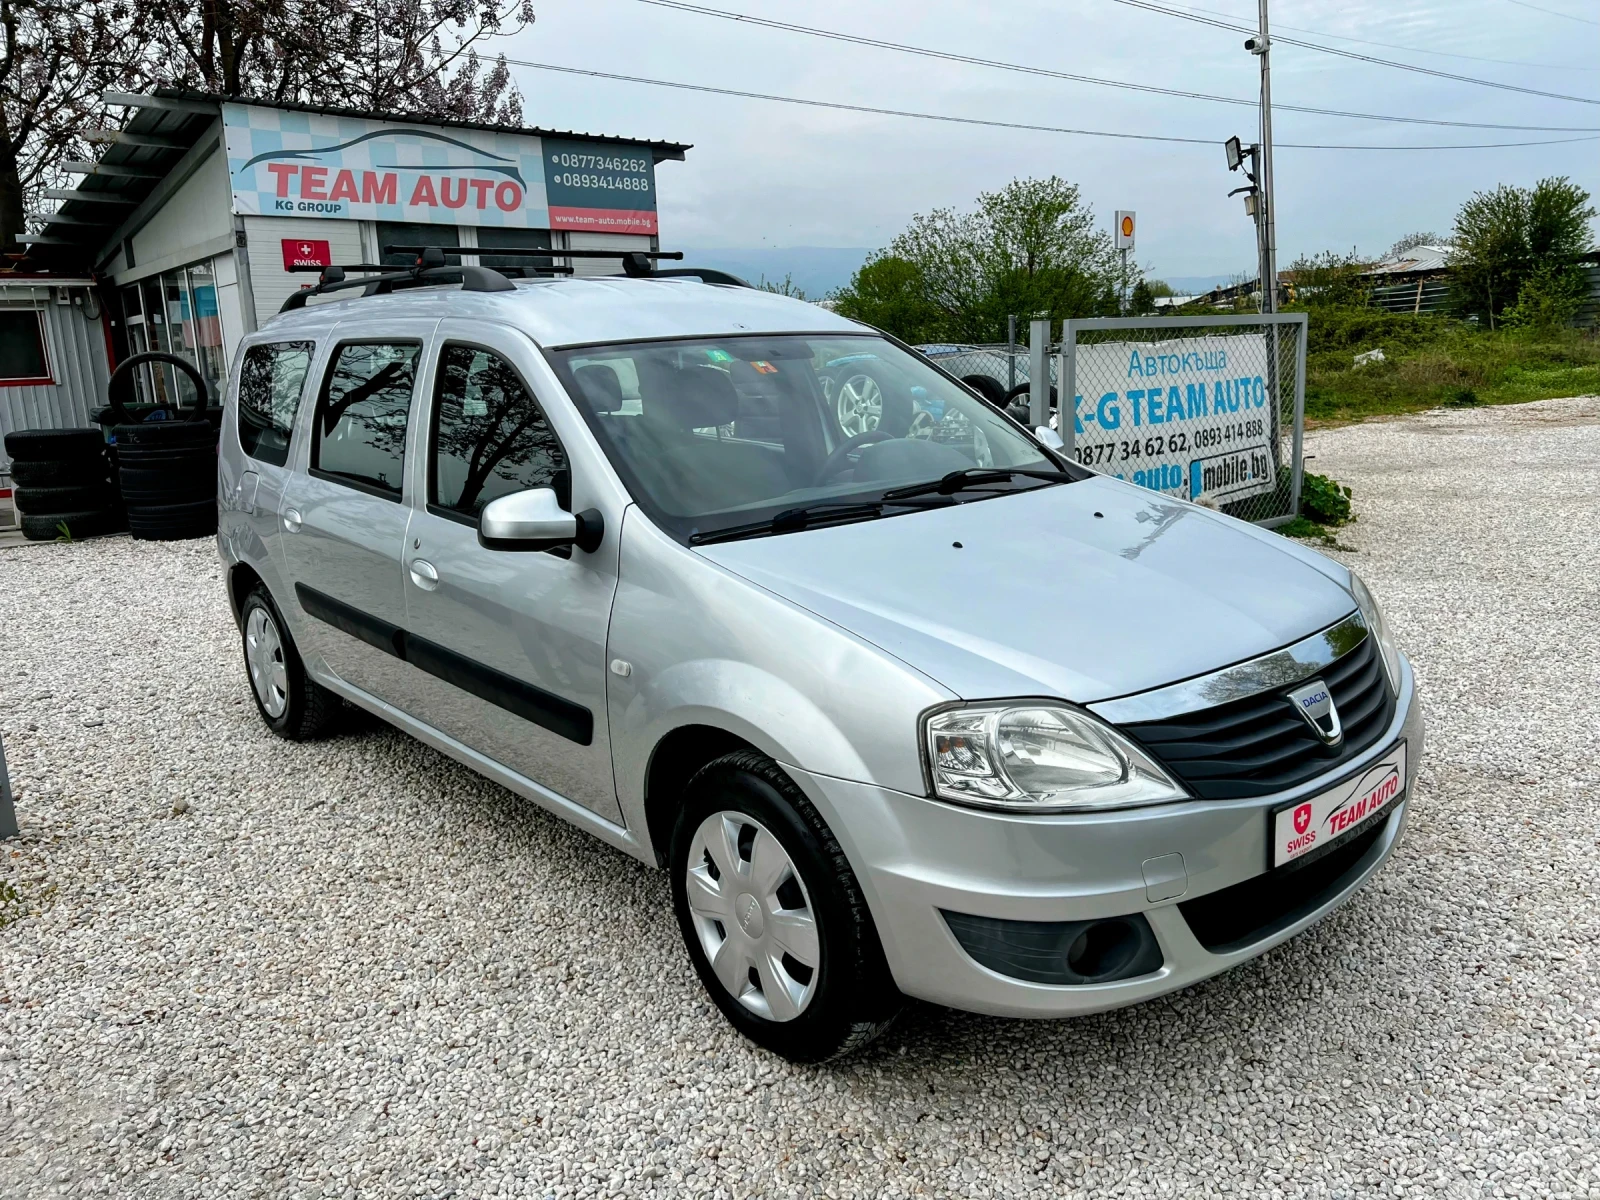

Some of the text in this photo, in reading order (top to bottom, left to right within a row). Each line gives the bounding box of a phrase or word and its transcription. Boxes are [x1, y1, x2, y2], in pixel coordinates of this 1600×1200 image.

[561, 153, 647, 173] 0877346262
[267, 163, 523, 212] TEAM AUTO
[563, 173, 649, 191] 0893414888
[275, 200, 342, 214] KG GROUP
[555, 215, 651, 228] www.team-auto.mobile.bg
[1127, 350, 1227, 378] Автокъща
[1127, 382, 1208, 427] TEAM
[1214, 375, 1265, 415] AUTO
[1121, 439, 1141, 460] 34
[1145, 436, 1165, 456] 62
[1194, 427, 1221, 448] 0893
[1225, 422, 1244, 442] 414
[1246, 419, 1263, 438] 888
[1302, 691, 1328, 708] DACIA
[1330, 775, 1398, 835] TEAM AUTO
[1287, 830, 1316, 853] SWISS
